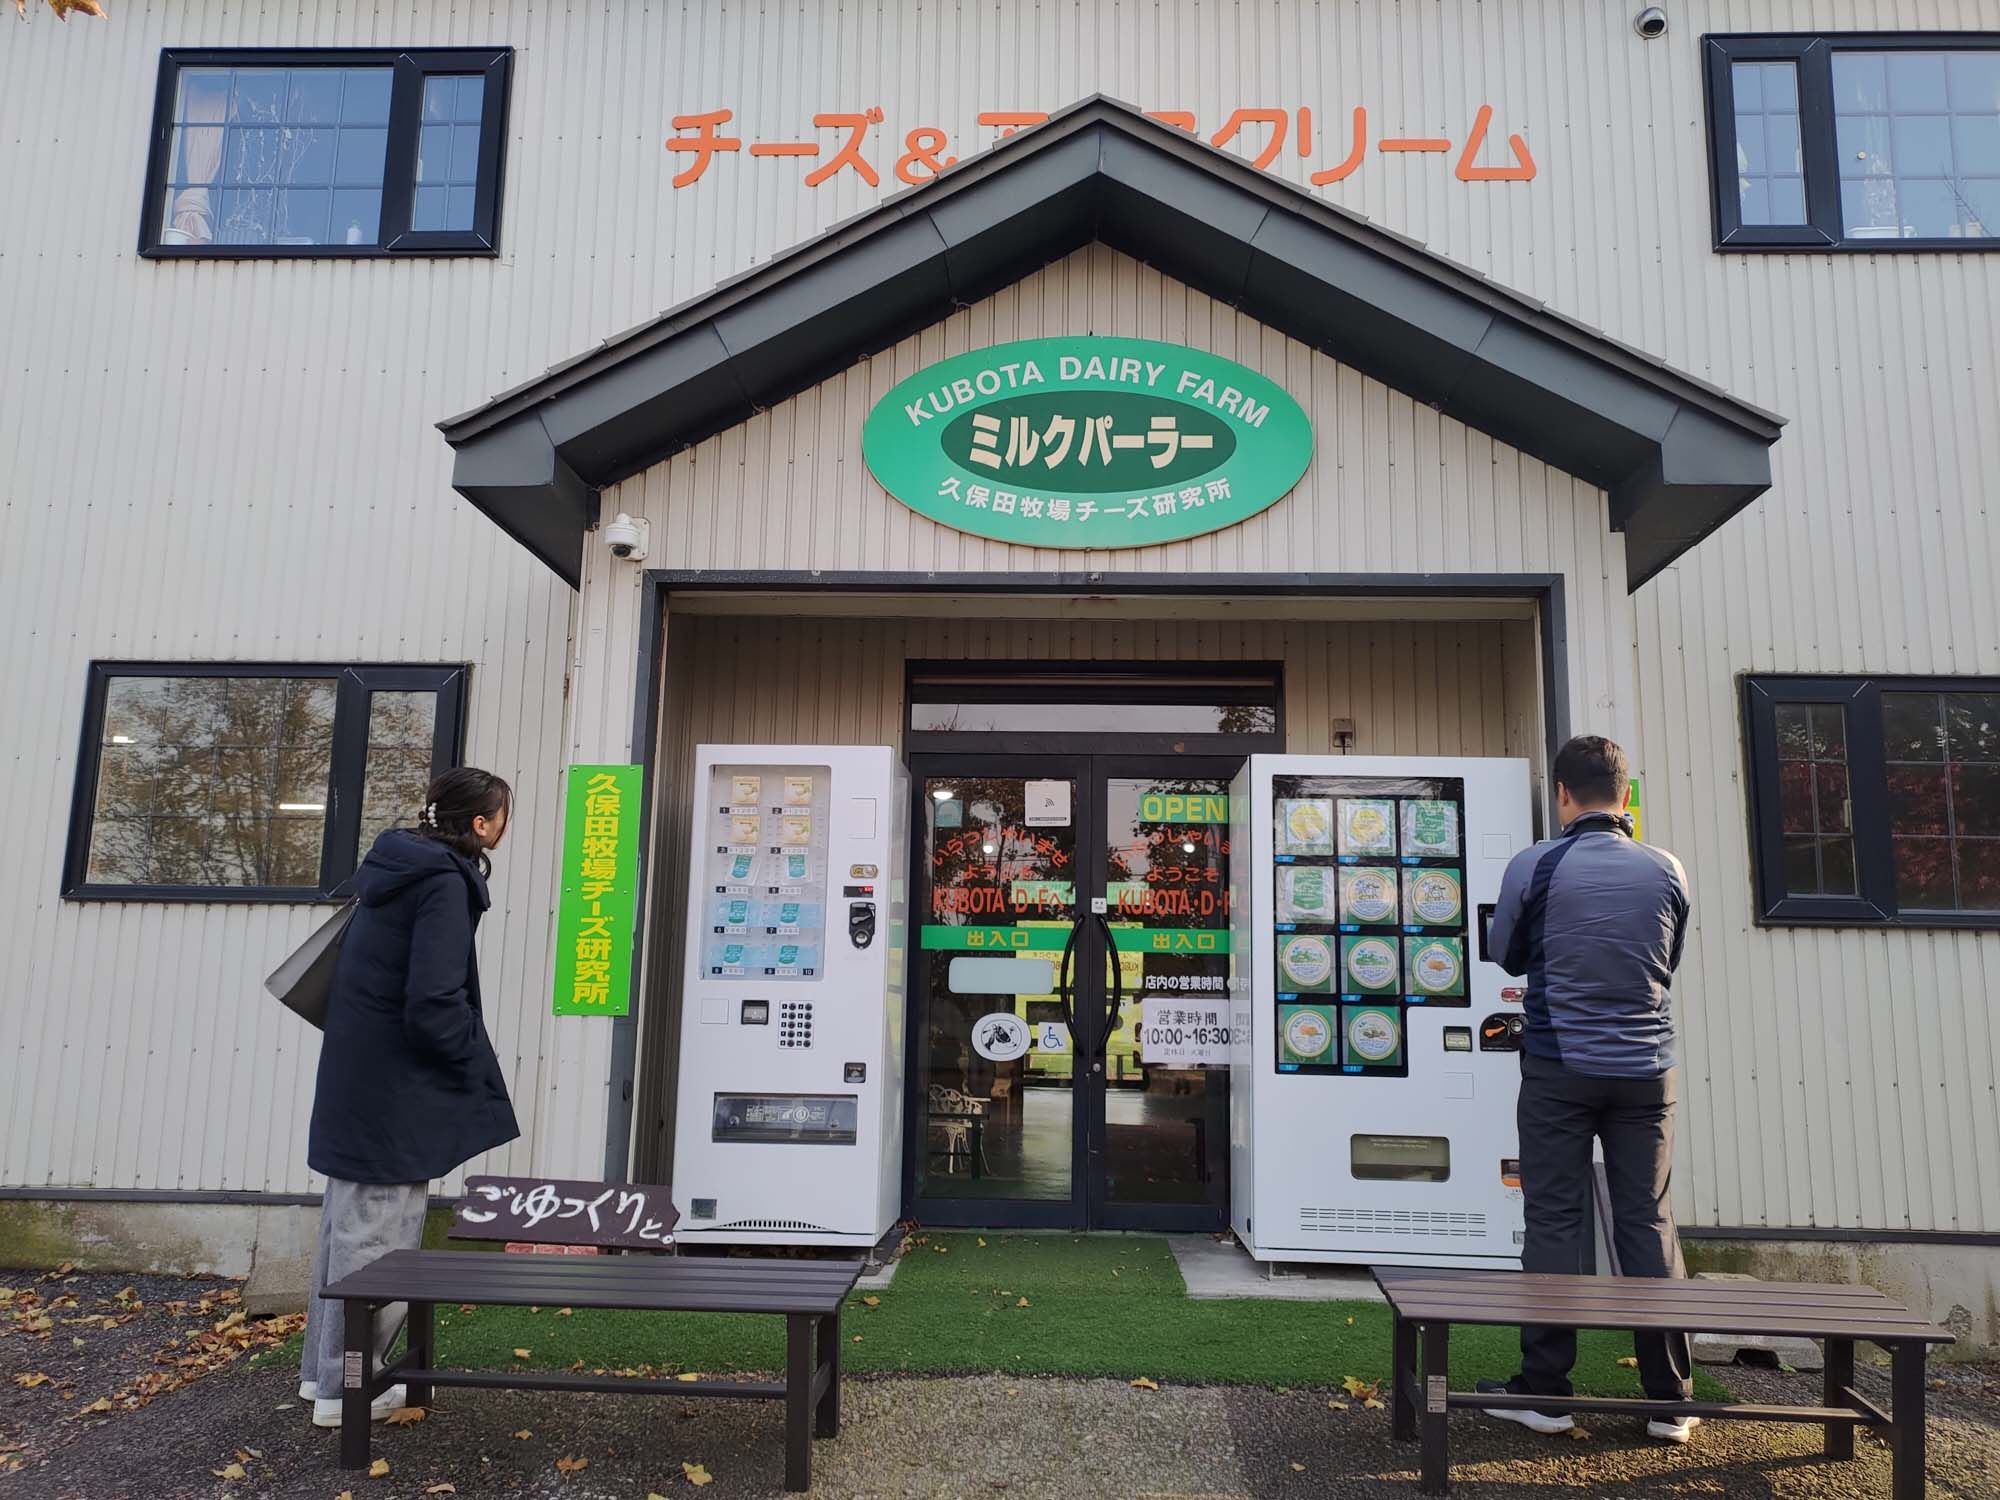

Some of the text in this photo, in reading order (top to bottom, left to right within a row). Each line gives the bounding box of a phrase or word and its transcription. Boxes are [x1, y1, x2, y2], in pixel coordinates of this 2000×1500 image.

[666, 105, 1537, 188] チーズ&クリーム
[904, 356, 1271, 429] KUBOTA DAIRY FARM
[968, 413, 1214, 470] ミルクパーラー
[936, 475, 1233, 522] 久保田牧場チーズ研究所
[1142, 796, 1226, 822] OPEN
[931, 826, 1069, 869] いらっしゃいませ
[571, 772, 623, 1006] 久保田牧場チーズ研究所
[1146, 865, 1220, 884] ようこそ
[966, 931, 1030, 947] 出入口
[1152, 932, 1216, 950] 出入口
[1144, 975, 1224, 991] 店内の営業時間
[1157, 1009, 1218, 1026] 営業時間
[456, 1184, 675, 1245] ごゆっくりと。
